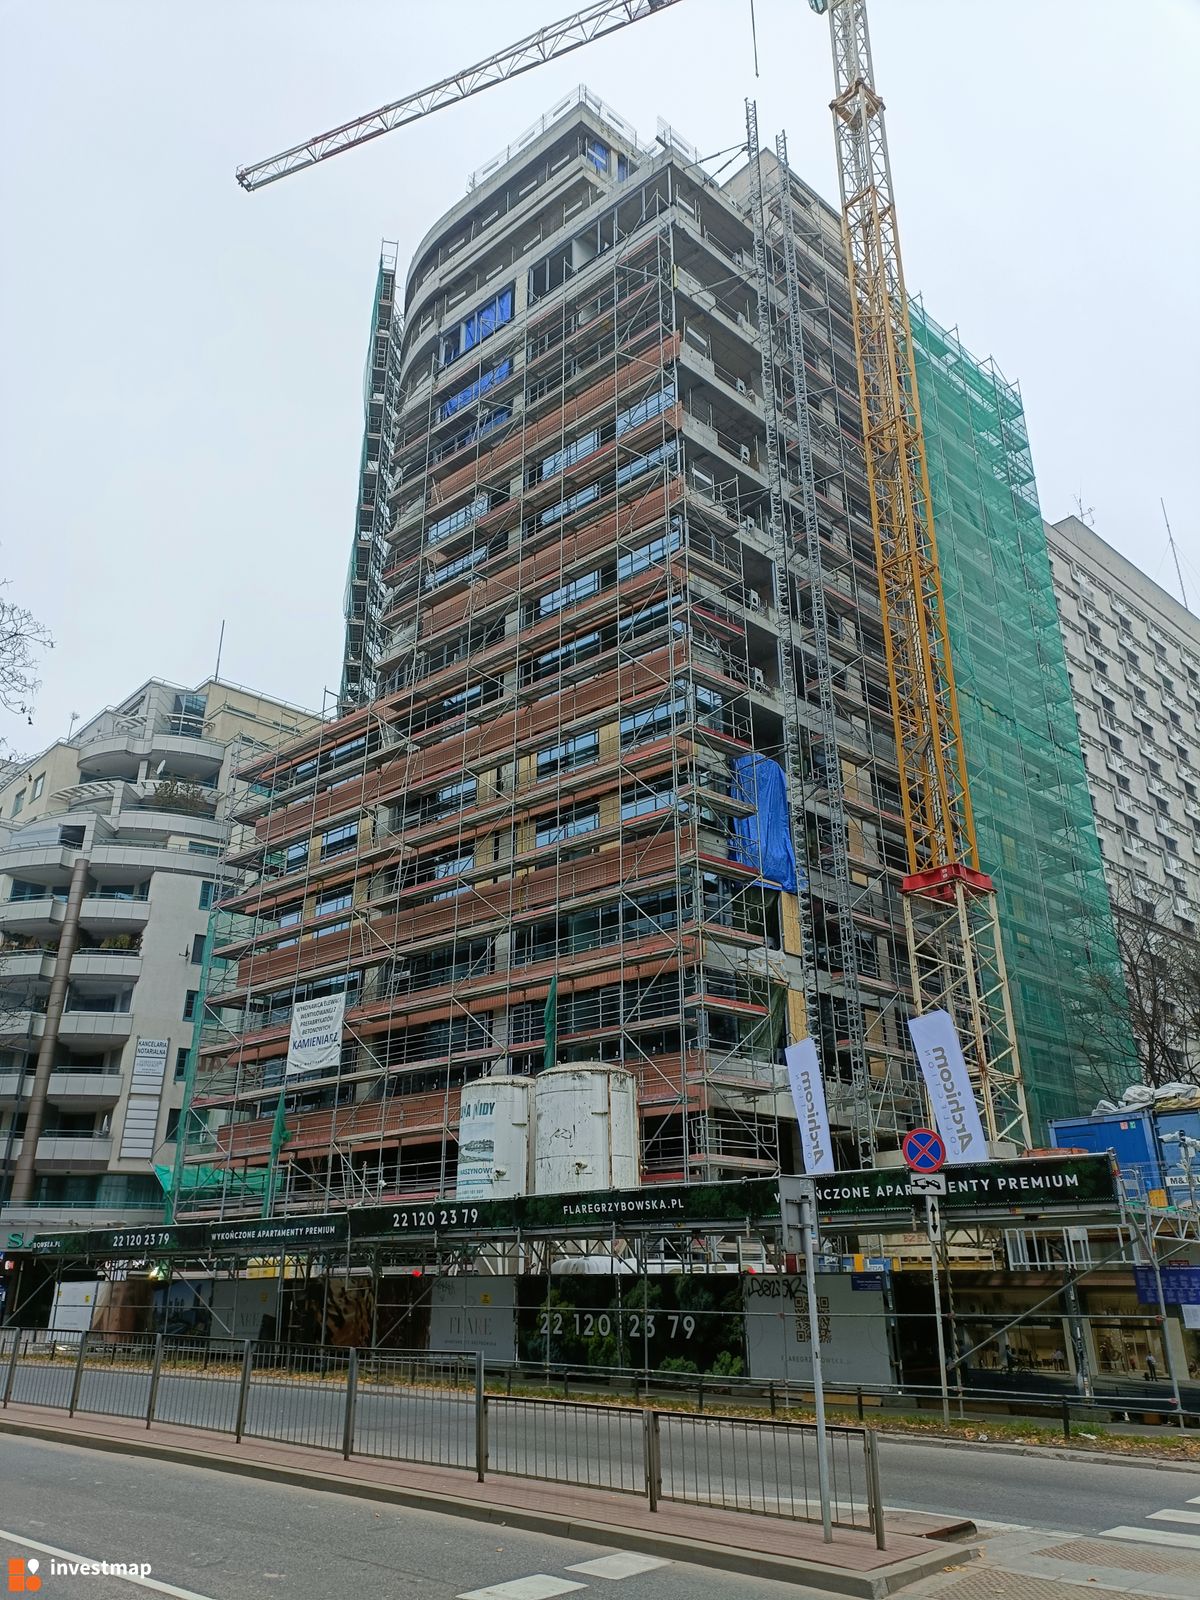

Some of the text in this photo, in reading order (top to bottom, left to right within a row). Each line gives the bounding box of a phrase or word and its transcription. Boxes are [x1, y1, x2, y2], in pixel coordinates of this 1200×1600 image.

[138, 1040, 168, 1048] KANCELARIA
[292, 1032, 338, 1050] KAMIENIARZ
[137, 1047, 166, 1055] NOTARIALNA
[774, 1174, 1079, 1204] WŃCZONE APARENTY PREMIUM
[563, 1199, 684, 1215] FLAREGRZYBOWSKA.PL
[393, 1208, 478, 1227] 22 120 23 79
[113, 1232, 170, 1247] 22 120 23 79
[211, 1226, 336, 1241] WYKOŃCZONE APARTAMENTY PREMIUM
[540, 1312, 696, 1339] 22 120 23 79
